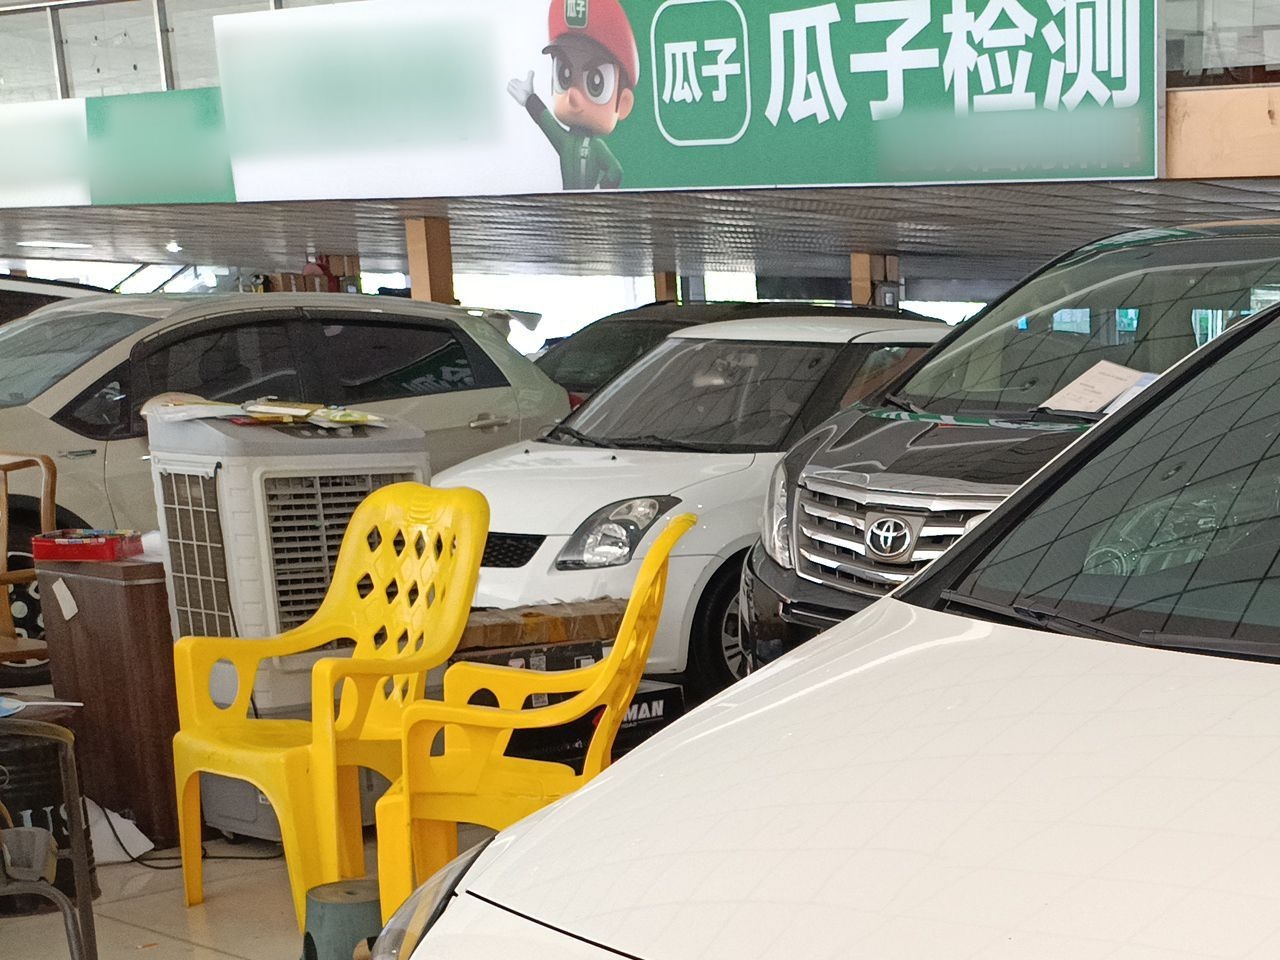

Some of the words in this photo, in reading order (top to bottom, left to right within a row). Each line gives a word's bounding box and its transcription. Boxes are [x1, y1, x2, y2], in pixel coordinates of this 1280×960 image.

[662, 37, 741, 104] 瓜子
[764, 0, 1141, 128] 瓜子检测
